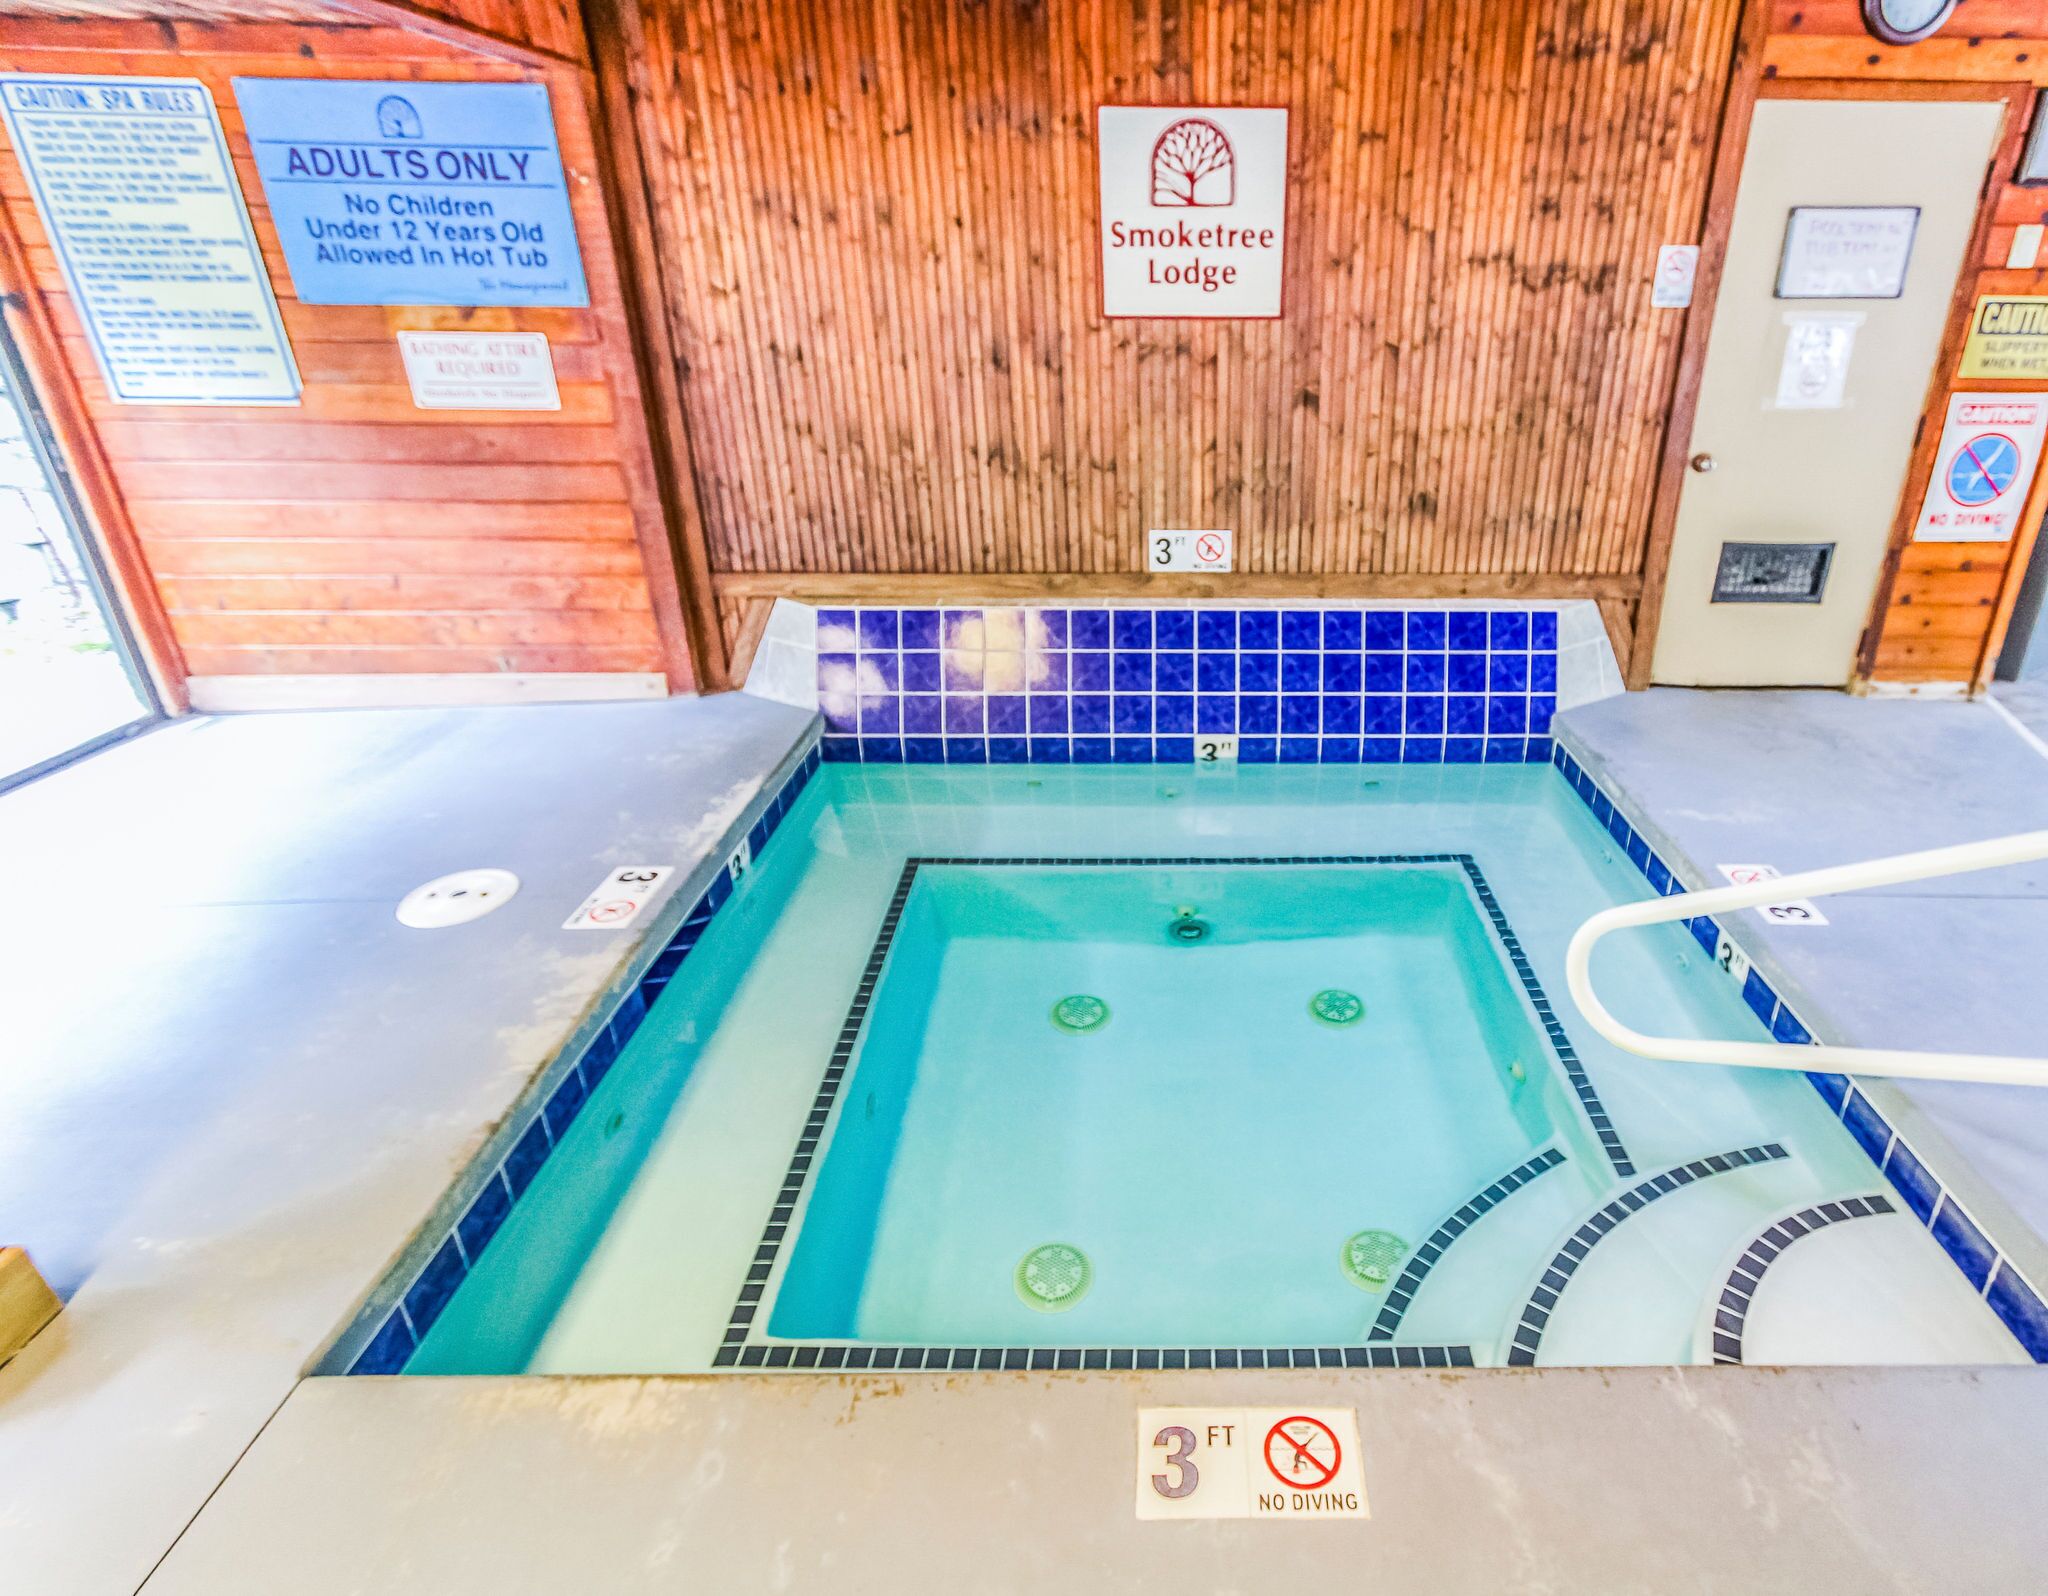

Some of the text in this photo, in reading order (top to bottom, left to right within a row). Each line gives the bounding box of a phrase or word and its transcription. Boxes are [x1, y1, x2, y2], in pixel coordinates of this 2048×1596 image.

[99, 89, 135, 109] SPA
[140, 90, 196, 112] RULES
[288, 147, 530, 181] ADULTS ONLY
[343, 193, 494, 217] No Children
[305, 217, 544, 243] Under 12 Years Old
[1111, 219, 1275, 248] Smoketree
[316, 243, 549, 268] Allowed In Hot Tub
[1148, 256, 1237, 293] Lodge
[1155, 538, 1172, 565] 3
[618, 871, 659, 882] 3
[1769, 907, 1810, 918] 3
[1151, 1425, 1236, 1499] 3 FT
[1259, 1493, 1359, 1512] NO DIVING
